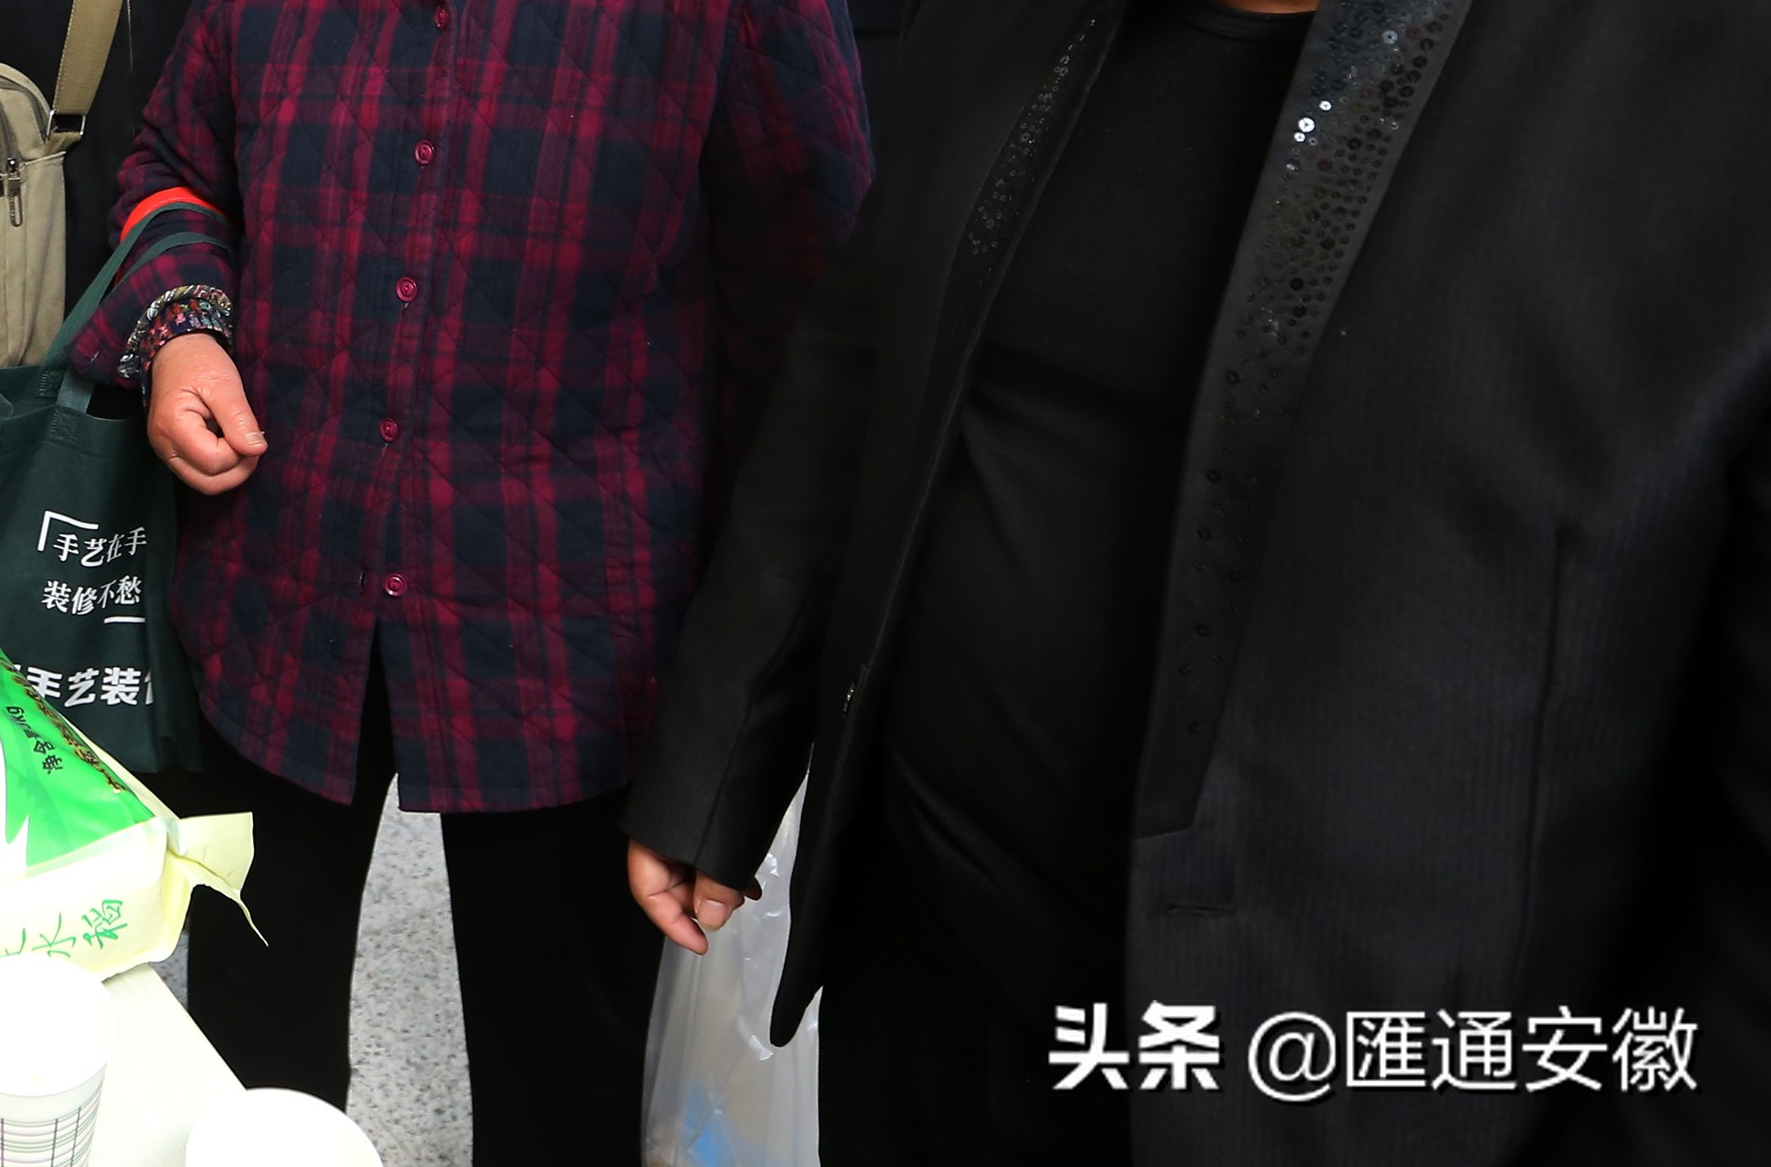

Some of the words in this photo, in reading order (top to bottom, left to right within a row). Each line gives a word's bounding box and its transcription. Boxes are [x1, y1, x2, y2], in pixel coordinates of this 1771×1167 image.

[53, 526, 148, 568] 手艺在手
[41, 575, 142, 616] 装修不愁
[14, 664, 154, 708] 手艺装
